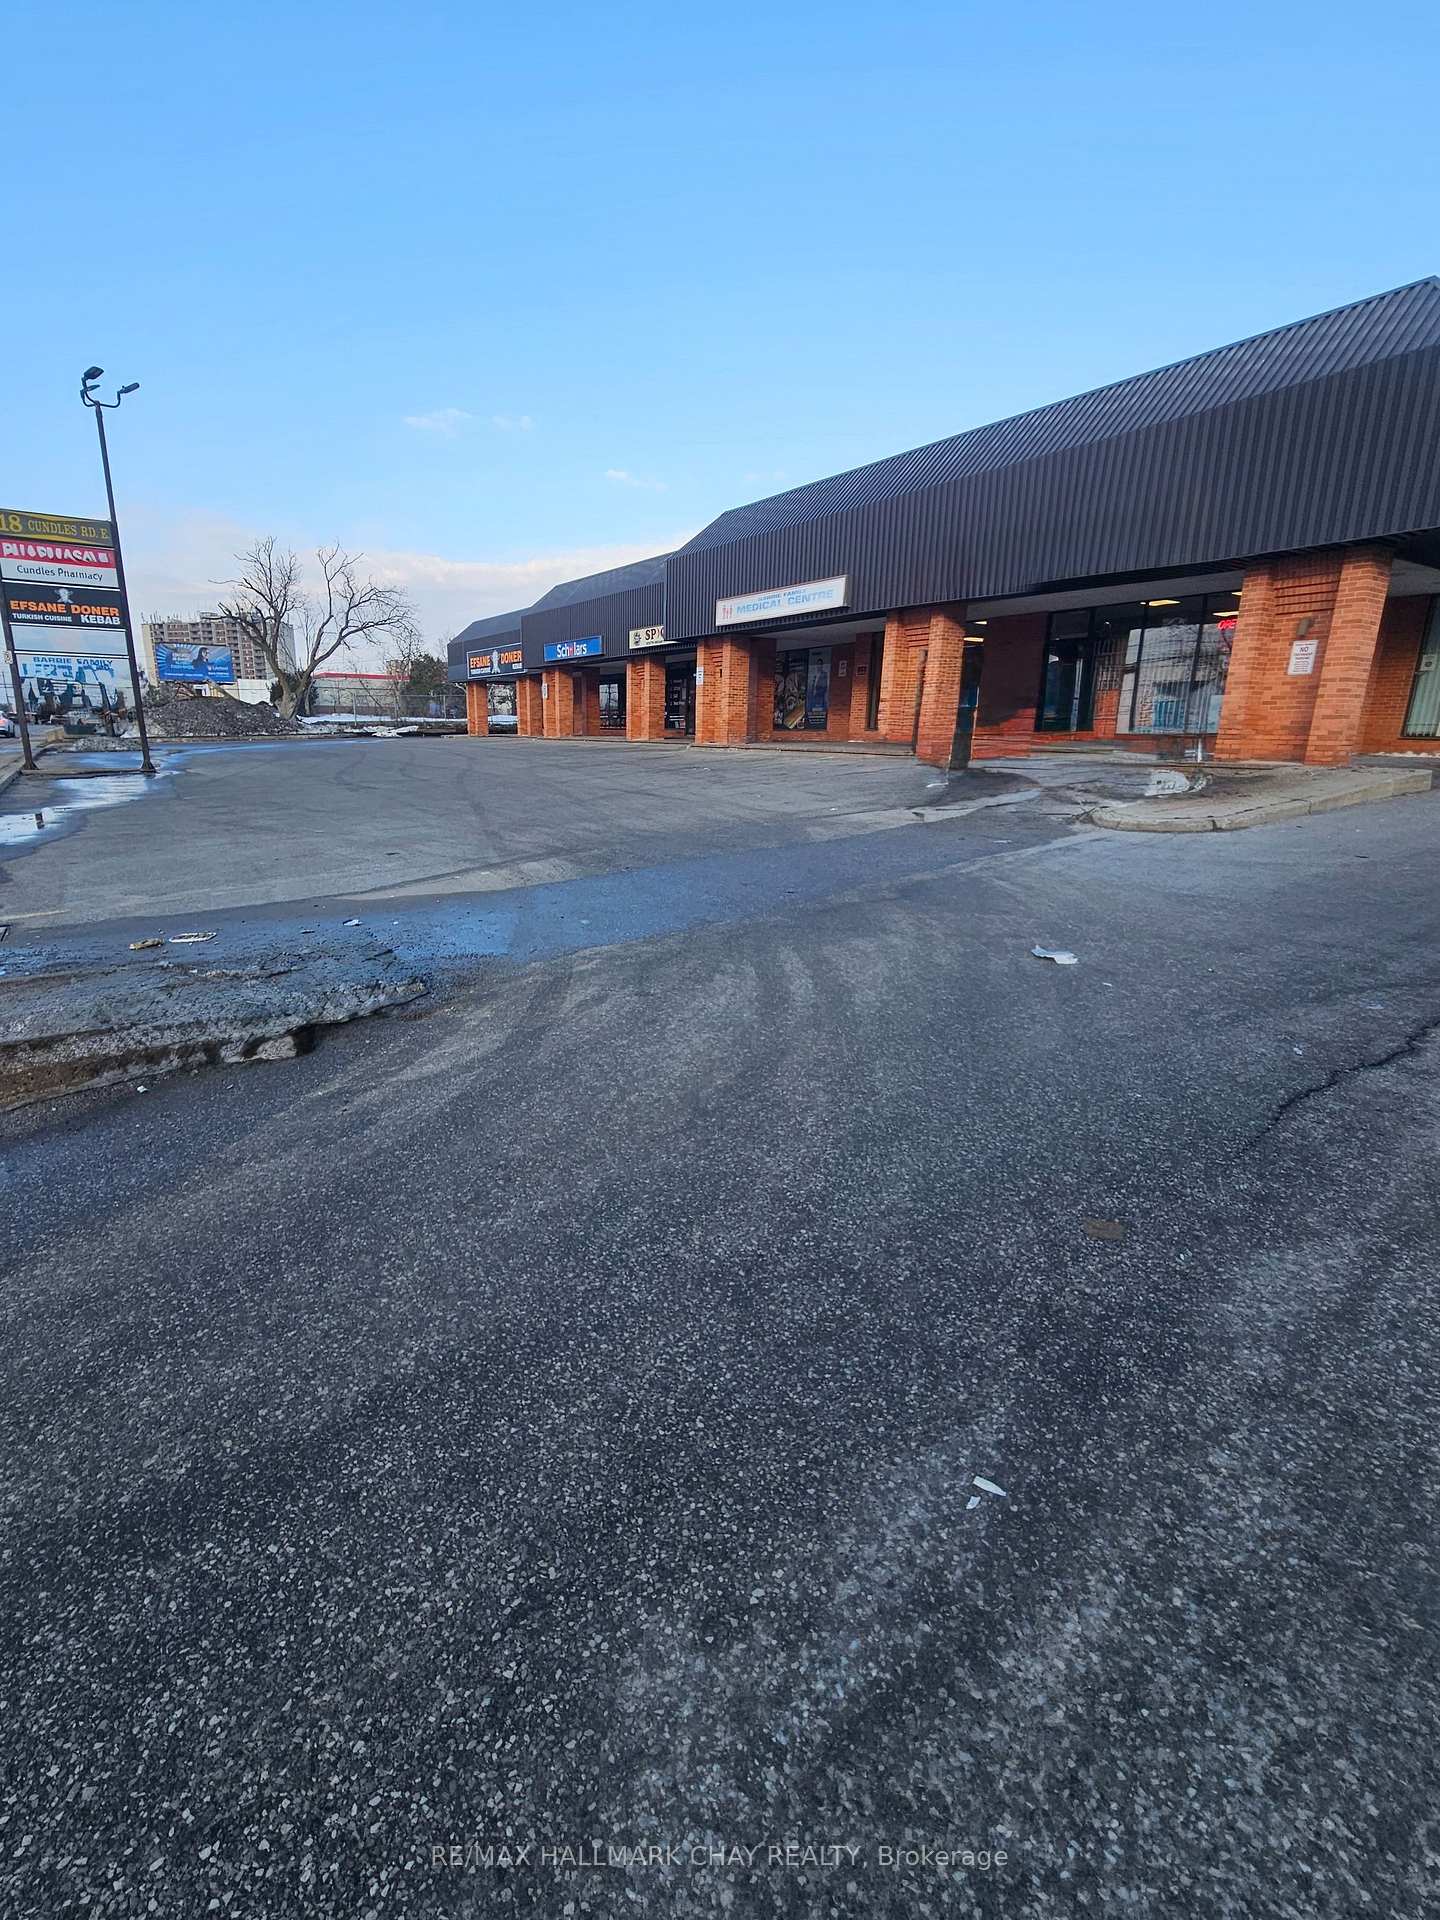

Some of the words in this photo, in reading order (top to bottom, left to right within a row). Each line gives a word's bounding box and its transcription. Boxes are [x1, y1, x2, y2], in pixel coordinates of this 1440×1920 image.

[27, 519, 78, 536] CUNDLES
[80, 526, 99, 539] RD.
[16, 565, 56, 577] Cundles
[57, 568, 103, 581] Pharmacy
[10, 600, 66, 613] EFSANE
[70, 604, 120, 617] DONER
[737, 599, 781, 614] MEDICAL
[788, 589, 834, 604] CENTRE
[12, 613, 43, 621] TURKISH
[44, 614, 72, 623] CUISINE
[80, 614, 121, 625] KEBAB
[1217, 619, 1239, 630] OPE
[556, 642, 587, 658] Scholars
[470, 655, 491, 669] EFSANE
[500, 650, 522, 665] DONER
